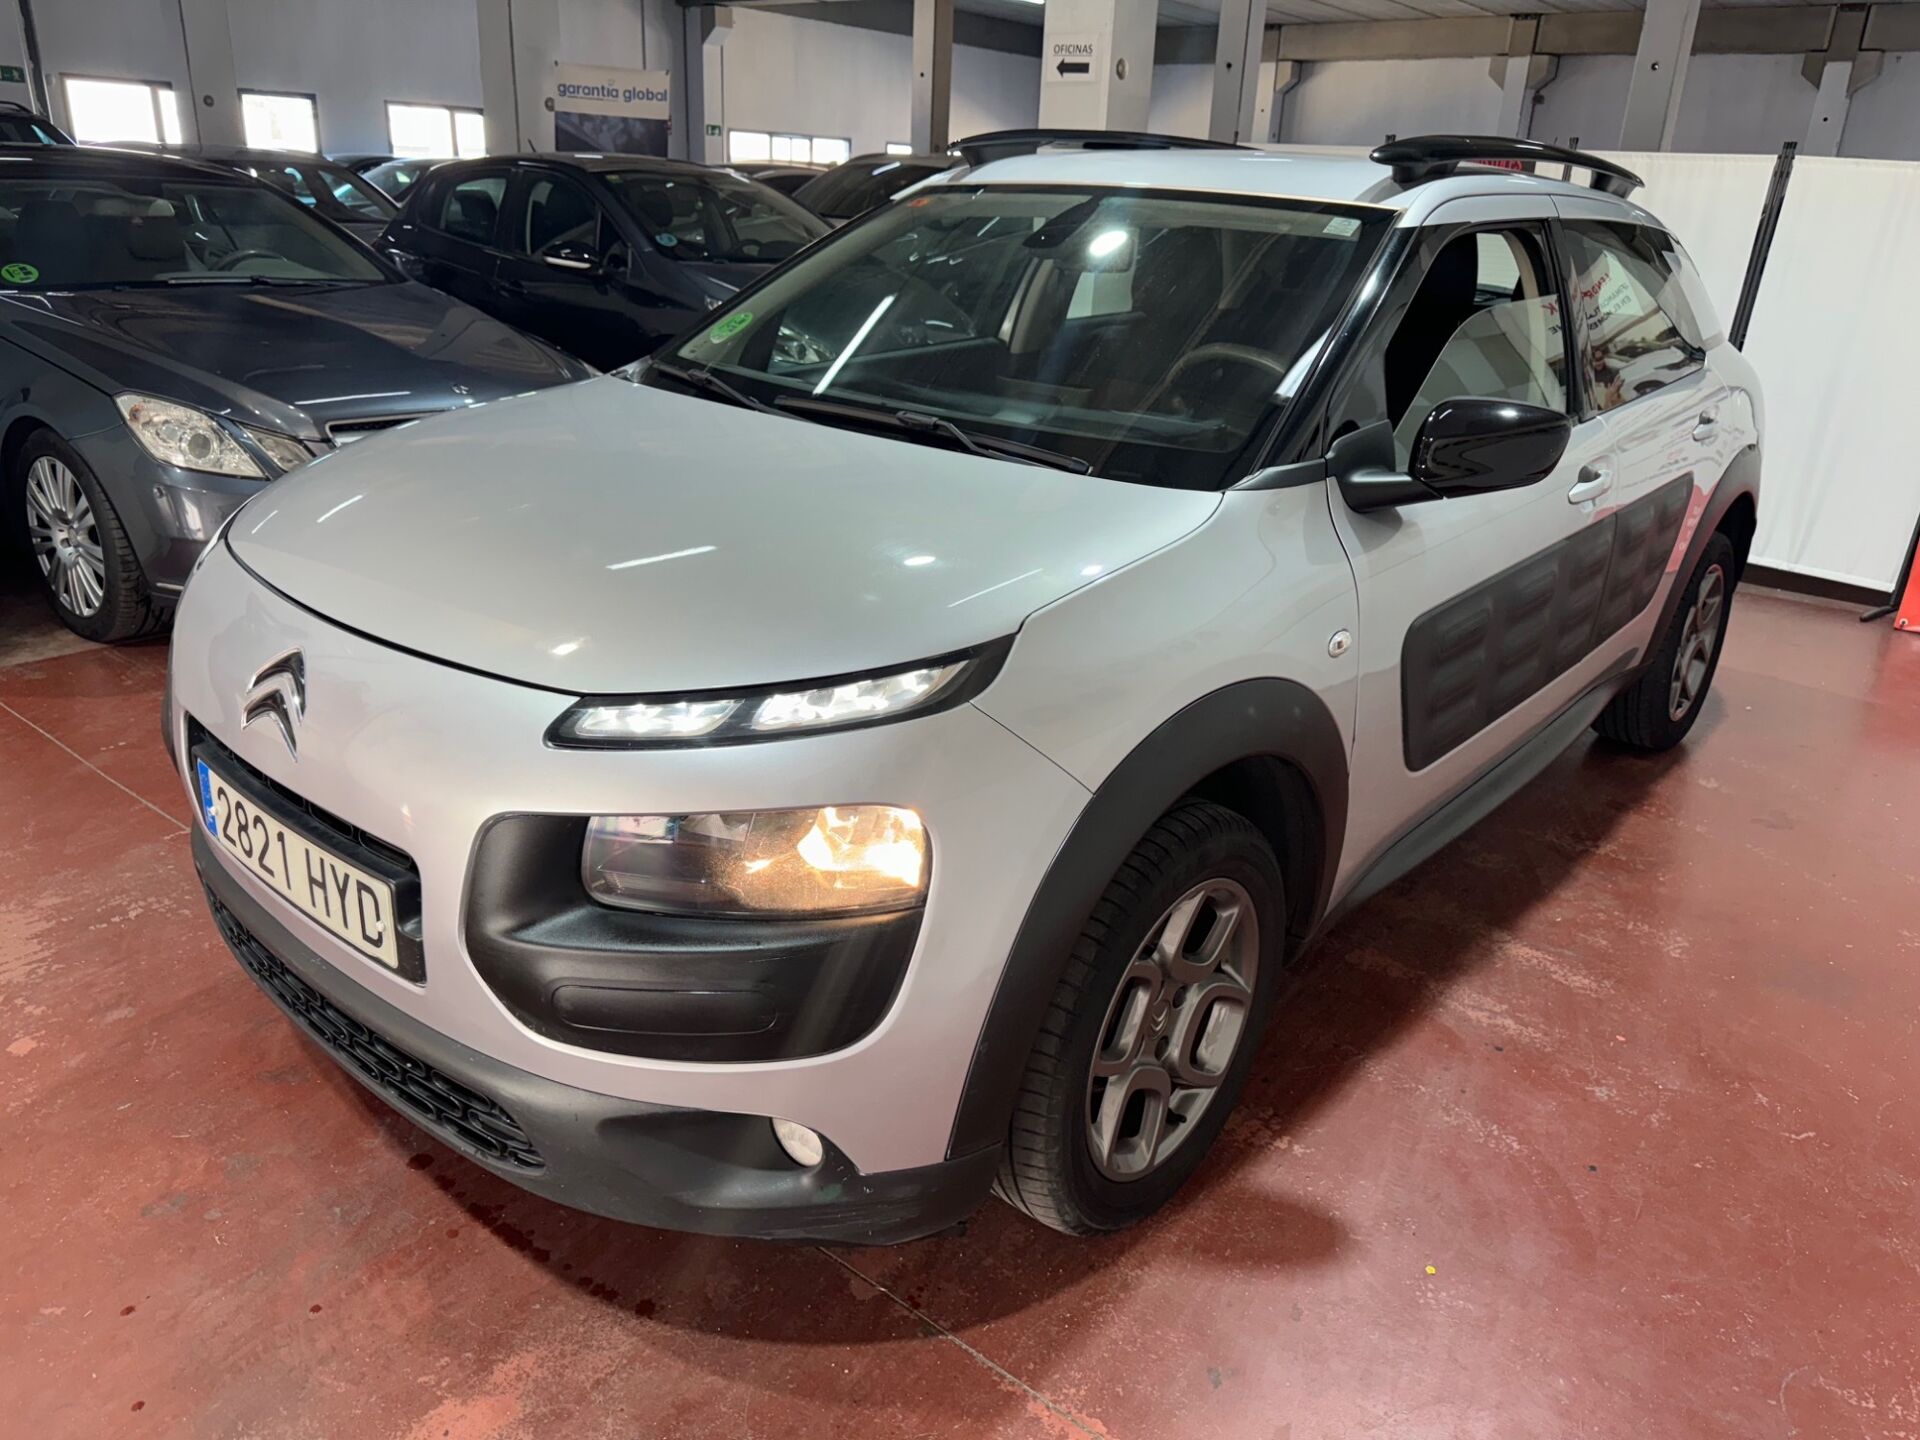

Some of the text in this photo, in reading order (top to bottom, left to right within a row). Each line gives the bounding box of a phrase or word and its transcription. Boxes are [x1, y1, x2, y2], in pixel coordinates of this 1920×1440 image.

[1053, 43, 1094, 55] OFICINAS
[622, 87, 668, 103] global
[217, 786, 384, 949] 2821 HYD
